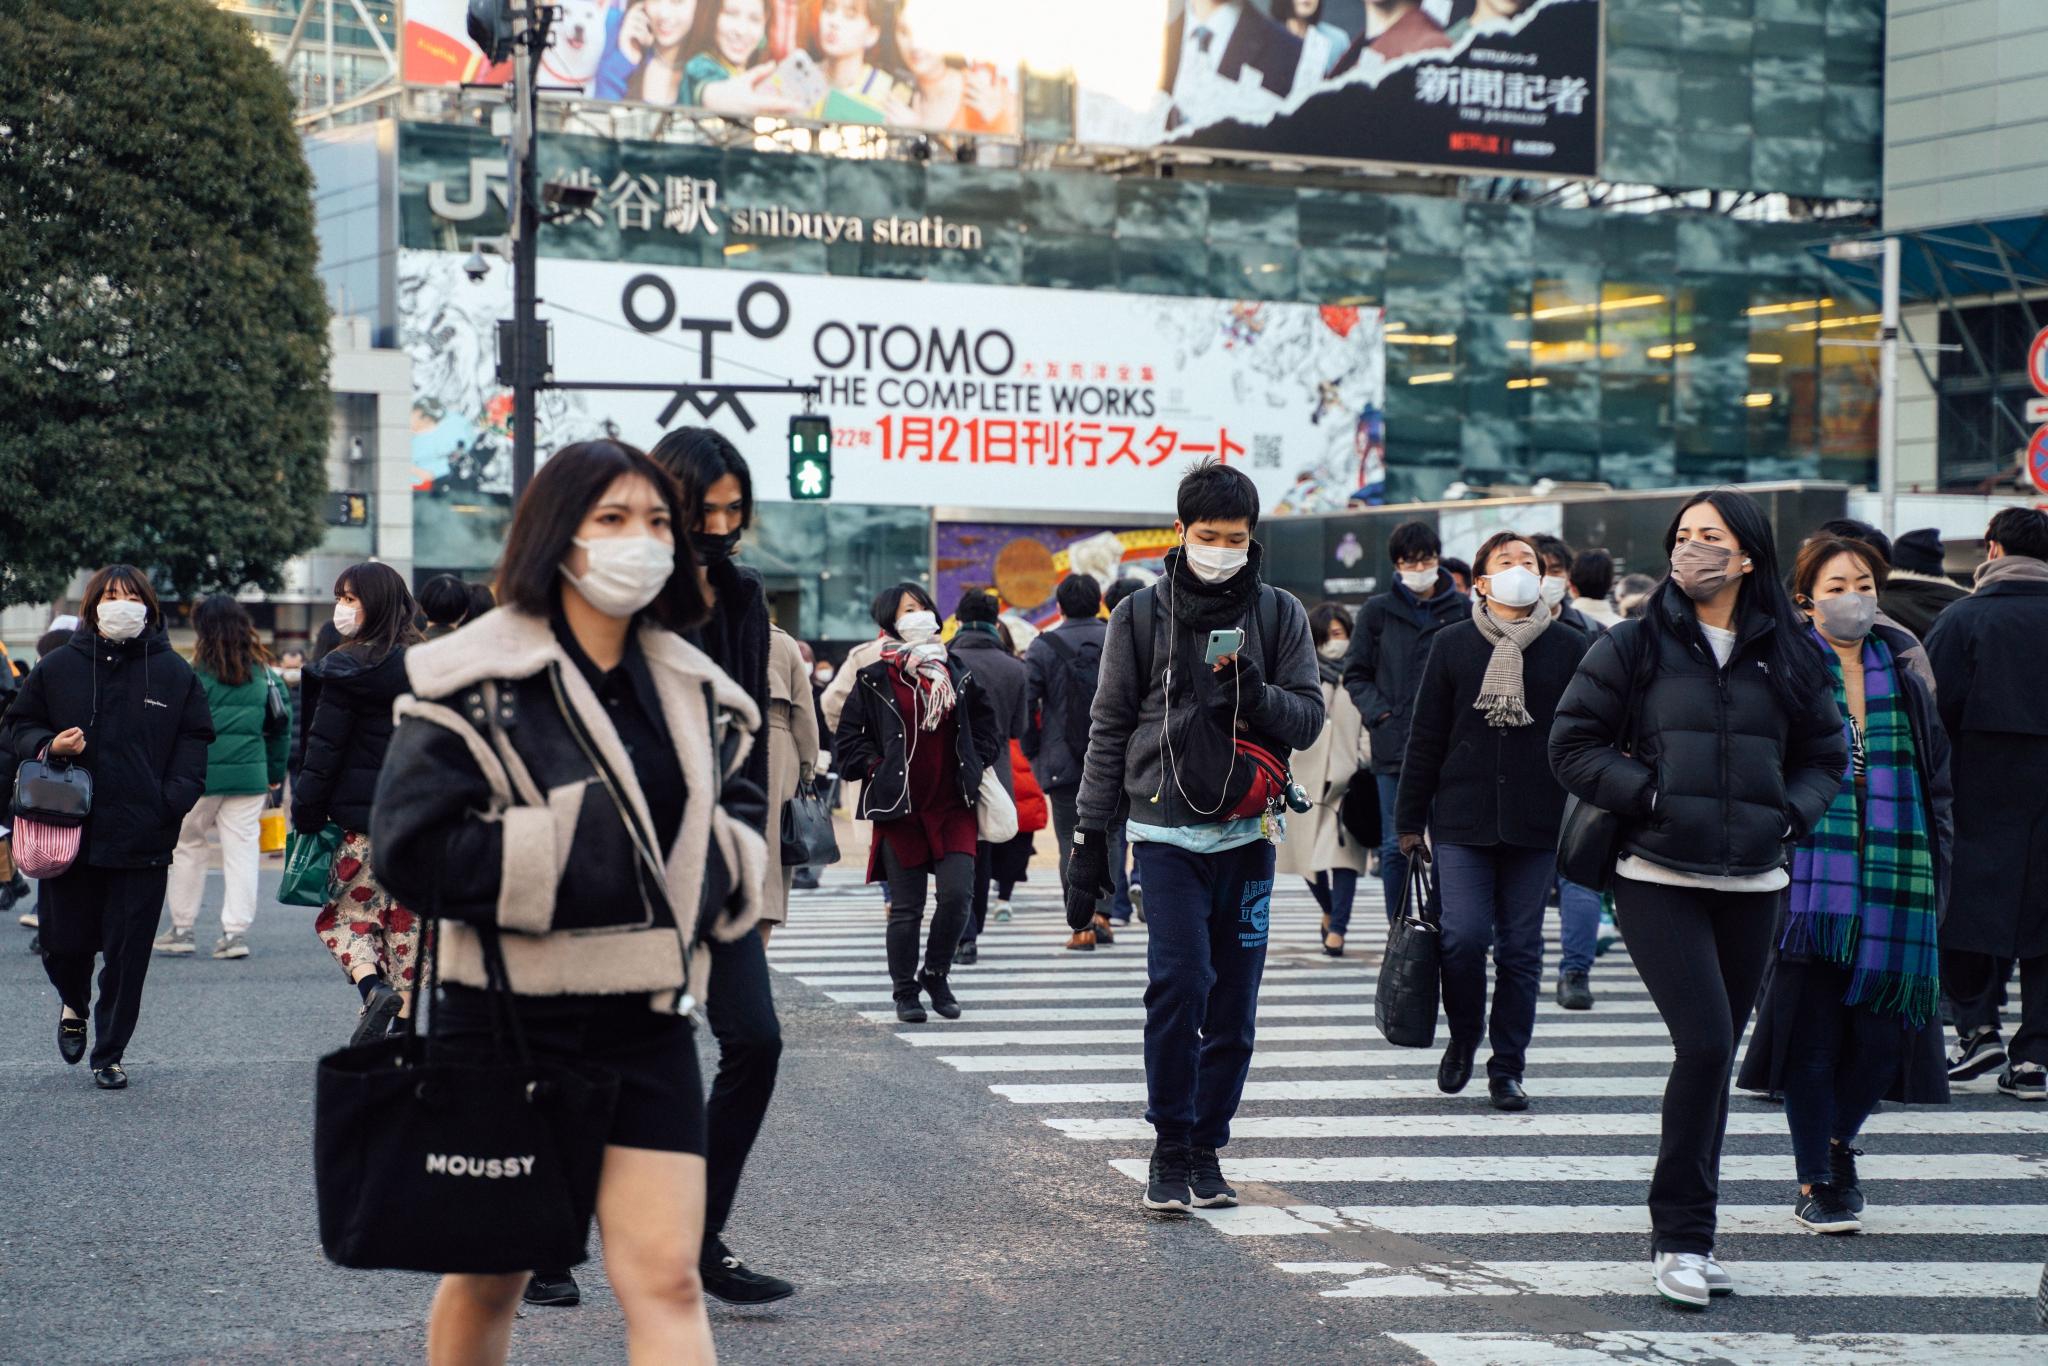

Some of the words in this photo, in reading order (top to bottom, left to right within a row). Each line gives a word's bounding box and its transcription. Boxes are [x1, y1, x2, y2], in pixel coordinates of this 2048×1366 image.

[1415, 64, 1590, 115] 新聞記者
[731, 205, 864, 244] shibuya
[872, 214, 982, 250] station
[813, 321, 1014, 376] OTOMO
[814, 375, 867, 406] THE
[877, 377, 1041, 413] COMPLETE
[1050, 385, 1156, 418] WORKS
[426, 1153, 536, 1179] MOUSSY
